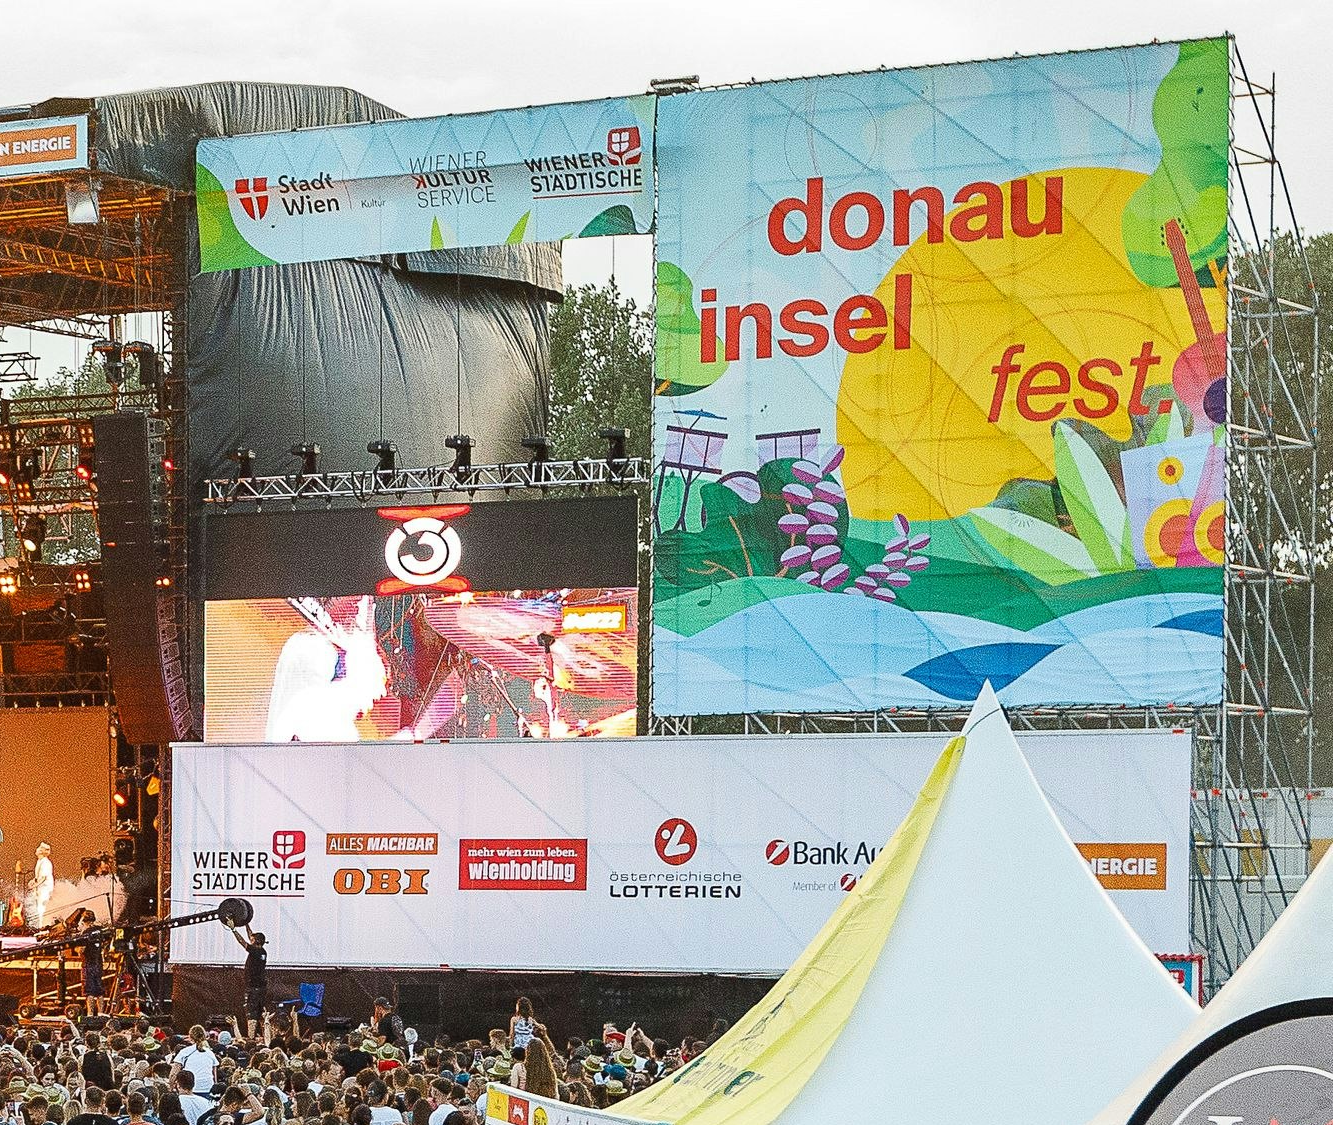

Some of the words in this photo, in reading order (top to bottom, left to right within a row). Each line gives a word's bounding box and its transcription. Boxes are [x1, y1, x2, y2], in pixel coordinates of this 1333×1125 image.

[12, 135, 71, 155] ENERGIE
[409, 150, 487, 174] WIENER
[524, 152, 606, 173] WIENER
[278, 171, 334, 195] Stadt
[532, 168, 642, 193] STÄDTISCHE
[282, 195, 340, 217] Wien
[361, 198, 386, 209] Kultur
[417, 186, 496, 209] SERVICE
[767, 177, 1064, 256] donau
[700, 274, 913, 364] insel
[987, 341, 1172, 423] fest.
[329, 836, 364, 852] ALLES
[366, 836, 435, 852] MACHBAR
[468, 847, 494, 858] mehr
[495, 847, 522, 858] wien
[523, 849, 544, 858] zum
[546, 846, 578, 858] leben.
[793, 841, 841, 866] Bank
[193, 851, 268, 869] WIENER
[1090, 858, 1158, 876] NERGIE
[193, 870, 306, 891] STÄDTISCHE
[333, 868, 430, 895] OBI
[609, 871, 742, 882] österreichische
[793, 881, 824, 892] Member
[826, 880, 837, 892] of
[609, 884, 742, 899] LOTTERIEN
